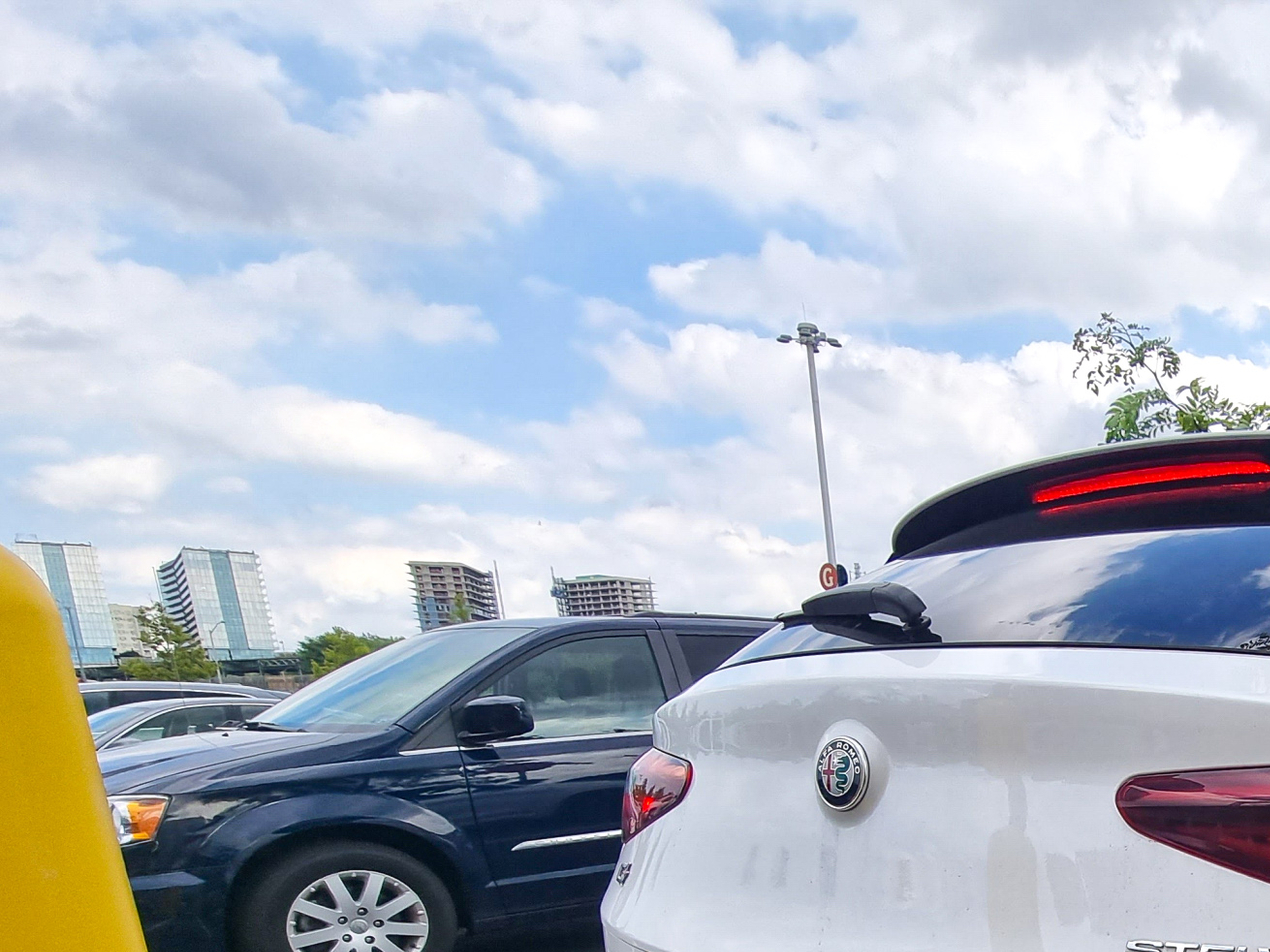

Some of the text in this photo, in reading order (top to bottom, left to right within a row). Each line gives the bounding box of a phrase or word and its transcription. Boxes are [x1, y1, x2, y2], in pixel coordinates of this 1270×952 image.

[822, 567, 834, 587] G
[818, 741, 860, 774] ALFA ROMEO
